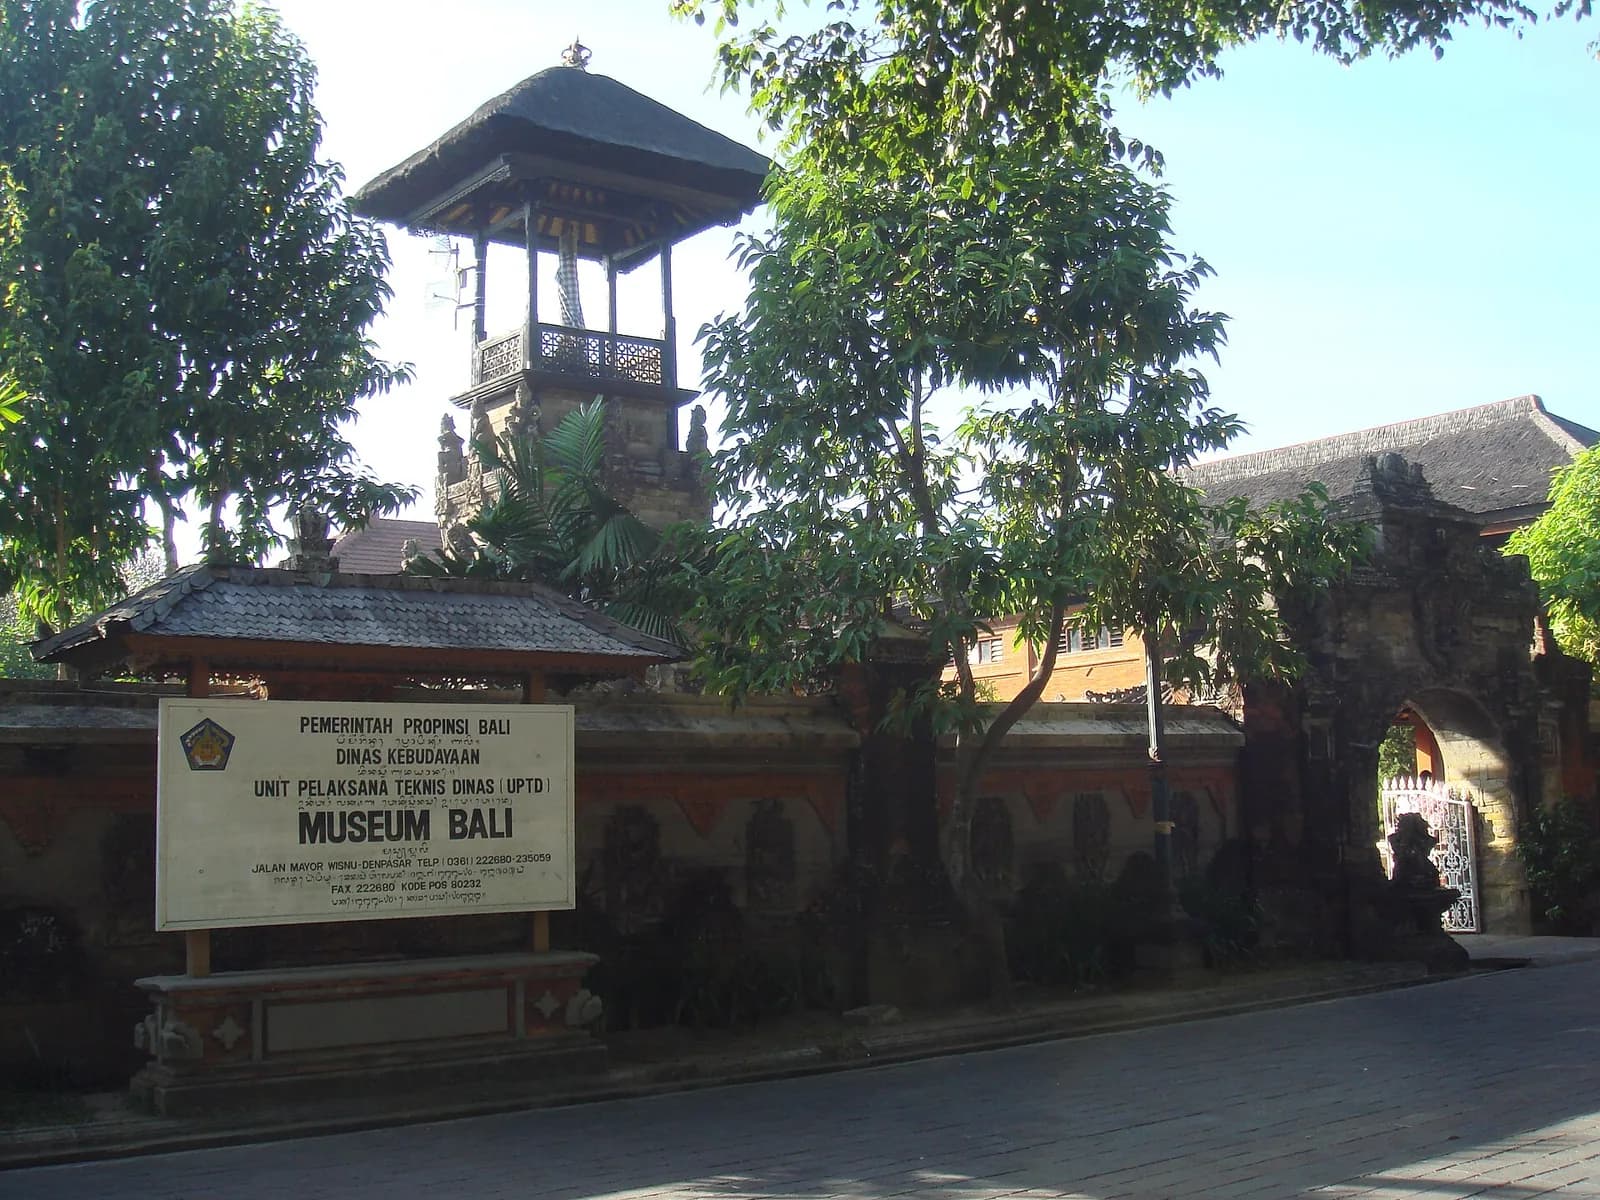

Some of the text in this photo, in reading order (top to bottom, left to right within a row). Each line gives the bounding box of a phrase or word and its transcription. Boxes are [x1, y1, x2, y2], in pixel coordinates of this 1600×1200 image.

[300, 716, 510, 735] PEMERINTAH PROPINSI BALI
[336, 748, 480, 765] DINAS KEBUDAYAAN
[254, 779, 290, 797] UNIT
[298, 779, 388, 797] PELAKSANA
[394, 778, 446, 796] TEKNIS
[452, 778, 494, 795] DINAS
[298, 807, 513, 844] MUSEUM BALI
[251, 863, 286, 873] JALAN
[290, 862, 324, 872] MAYOR
[417, 858, 440, 868] TELP
[356, 883, 396, 893] 222680
[401, 881, 427, 891] KODE
[429, 880, 448, 890] POS
[451, 879, 482, 889] 80232
